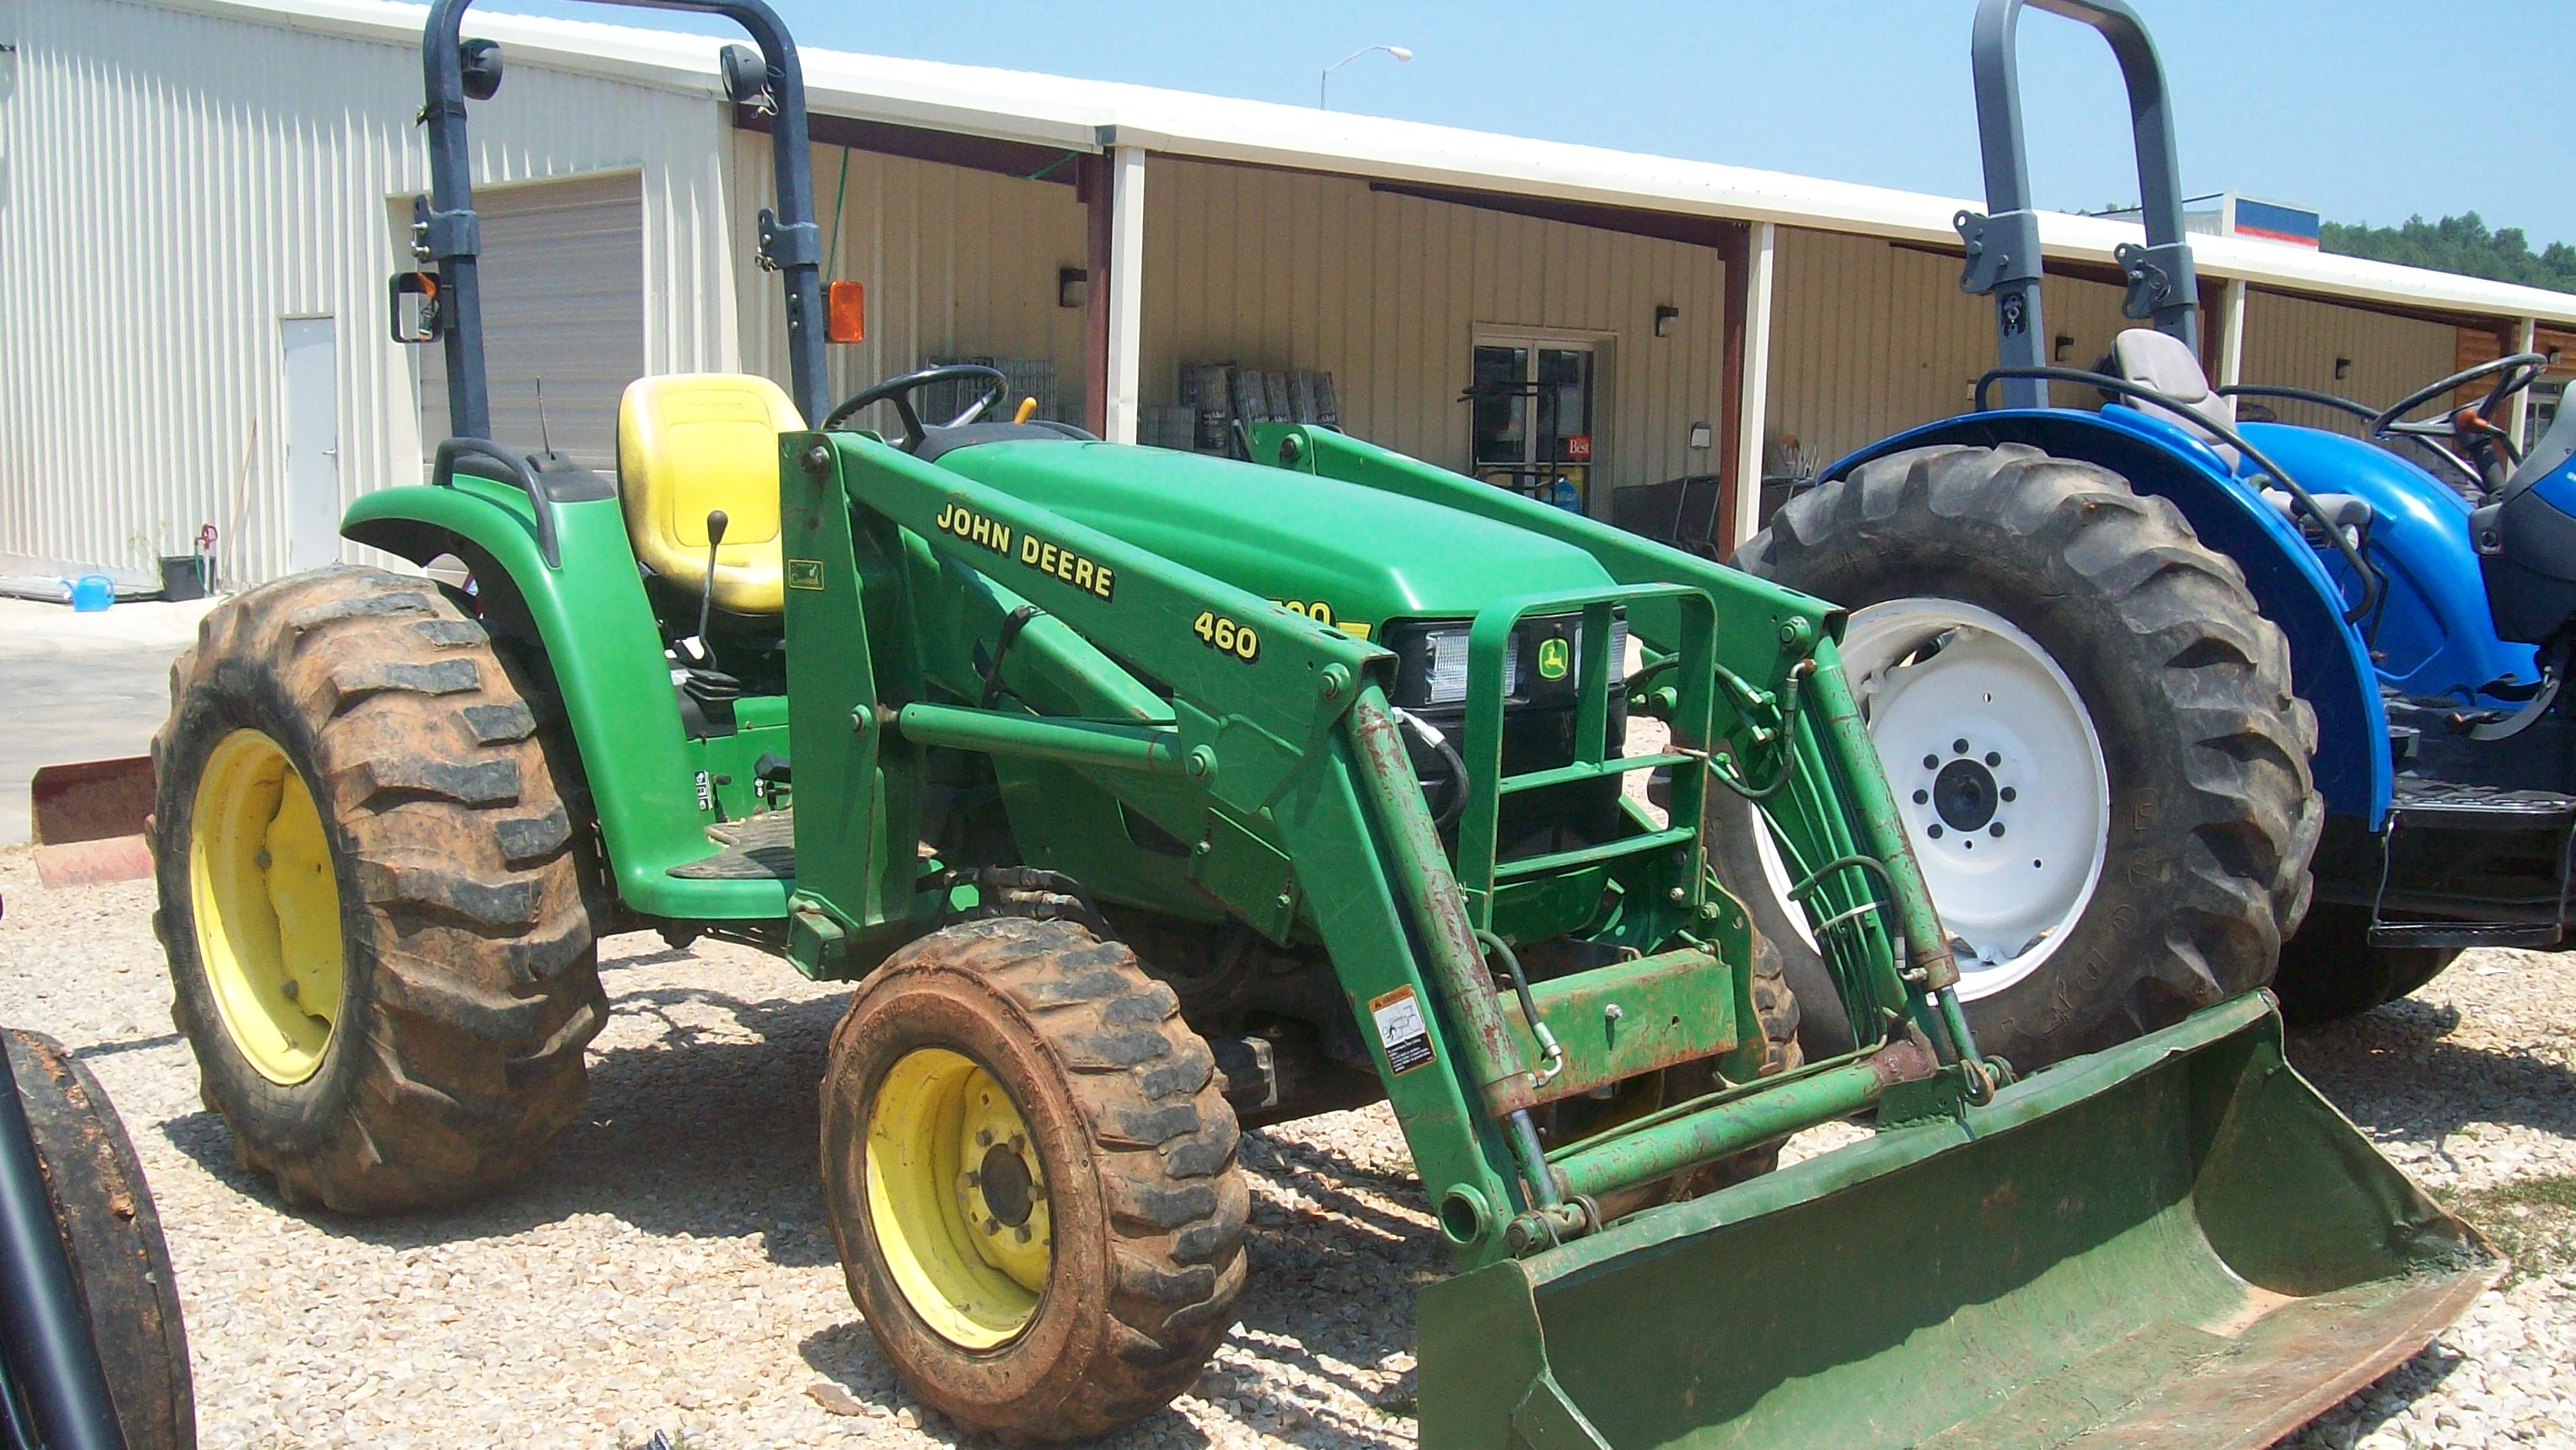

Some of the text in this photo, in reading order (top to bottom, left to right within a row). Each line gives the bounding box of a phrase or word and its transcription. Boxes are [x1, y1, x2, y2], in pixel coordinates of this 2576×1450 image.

[1569, 438, 1590, 454] Best
[936, 502, 1114, 599] JOHN DEERE
[1194, 610, 1258, 661] 460
